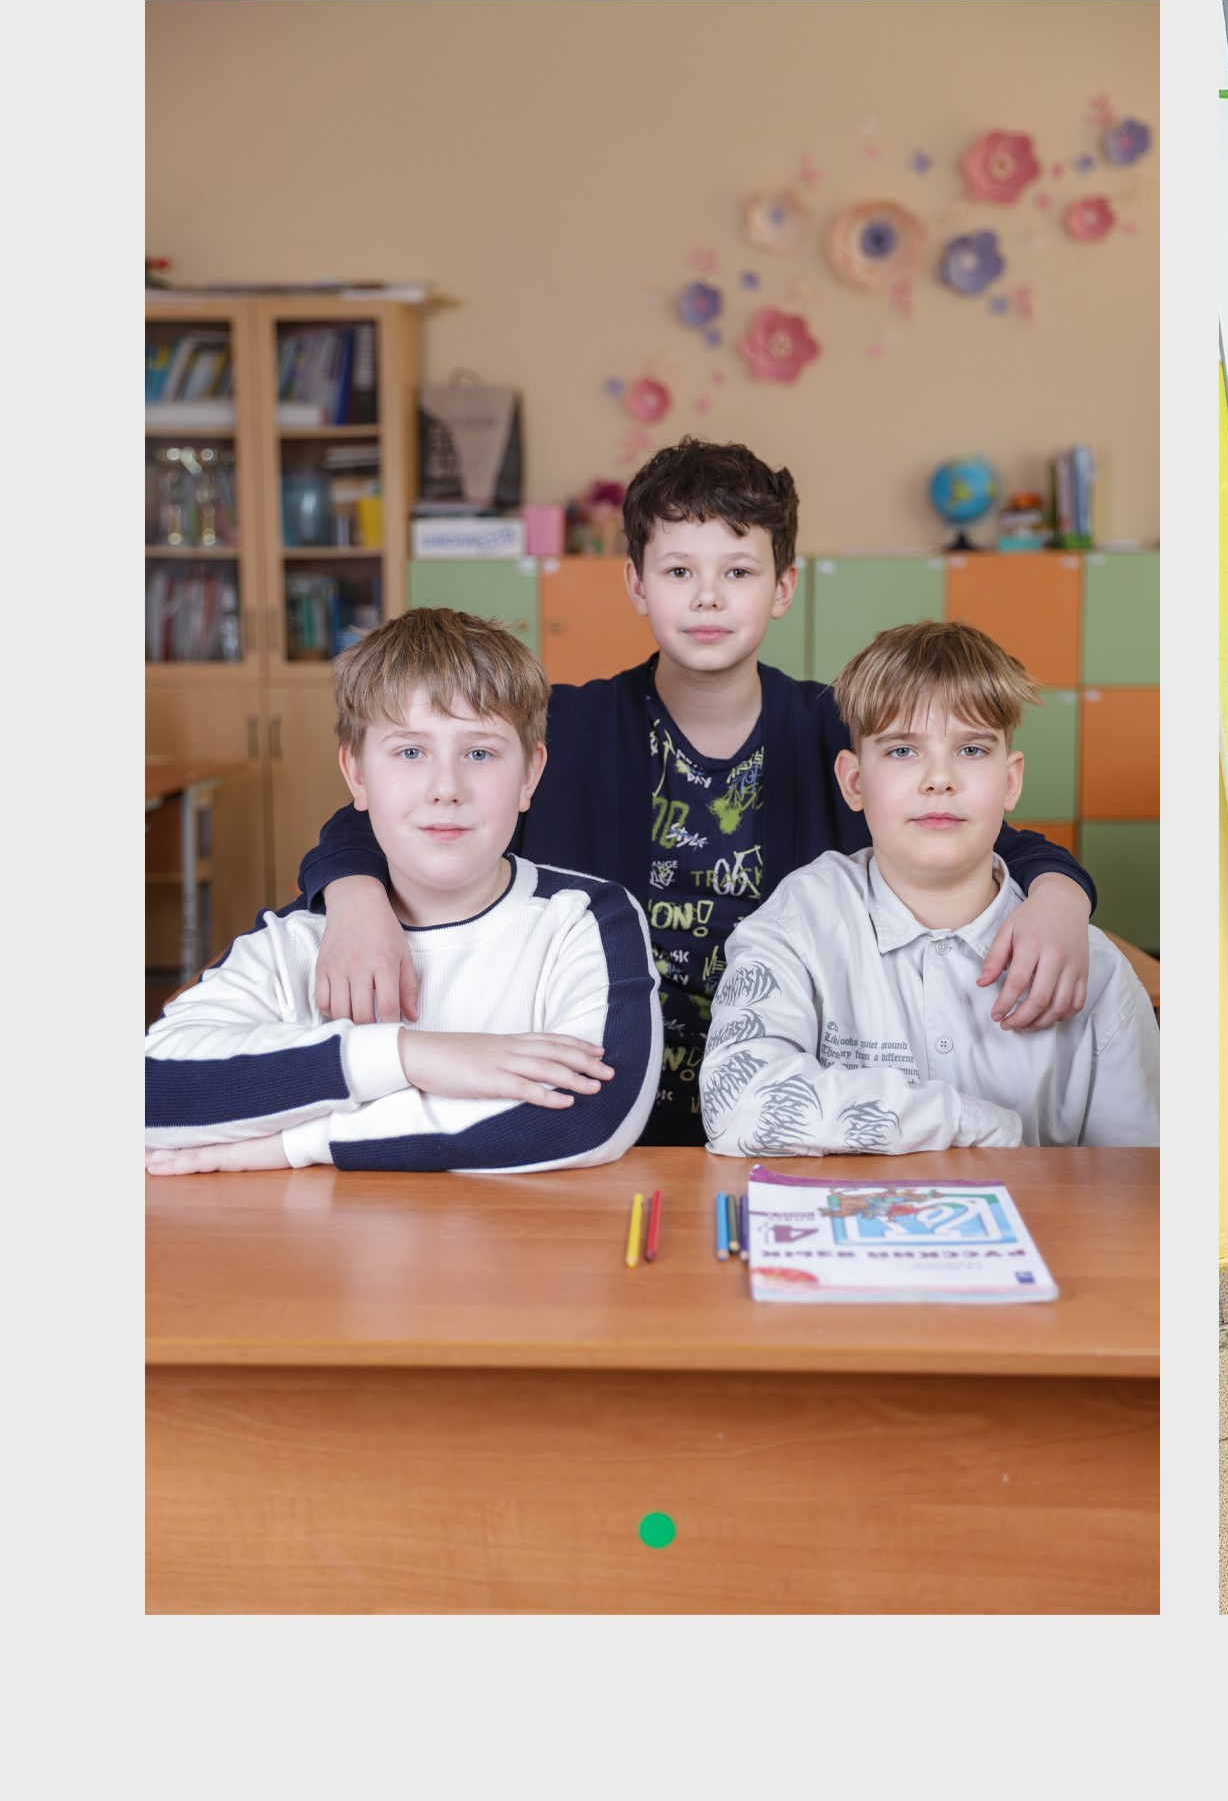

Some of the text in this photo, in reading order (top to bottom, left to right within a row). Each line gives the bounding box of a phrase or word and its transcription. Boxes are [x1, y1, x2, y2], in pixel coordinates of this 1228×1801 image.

[840, 1037, 859, 1047] ooks
[880, 1041, 908, 1050] around
[881, 1052, 914, 1063] different
[771, 1225, 819, 1243] 4
